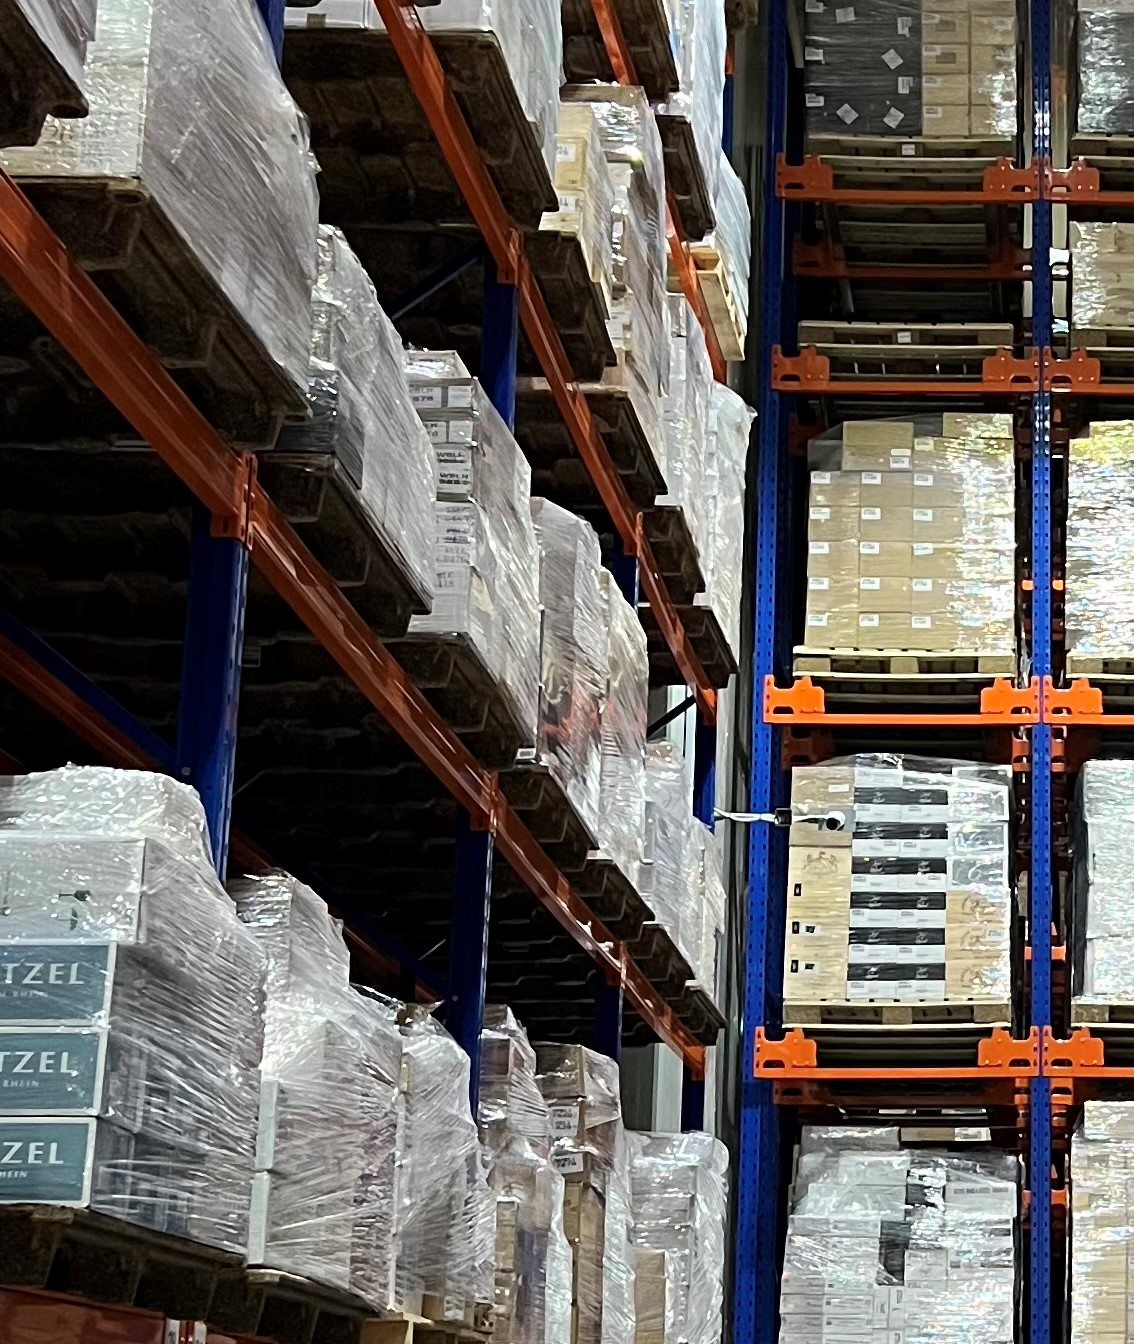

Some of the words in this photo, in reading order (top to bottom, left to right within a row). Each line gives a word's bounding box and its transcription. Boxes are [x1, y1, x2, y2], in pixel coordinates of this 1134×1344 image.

[1, 962, 85, 985] TZEL
[2, 1079, 39, 1088] RHEIN
[0, 1140, 64, 1165] ZEL
